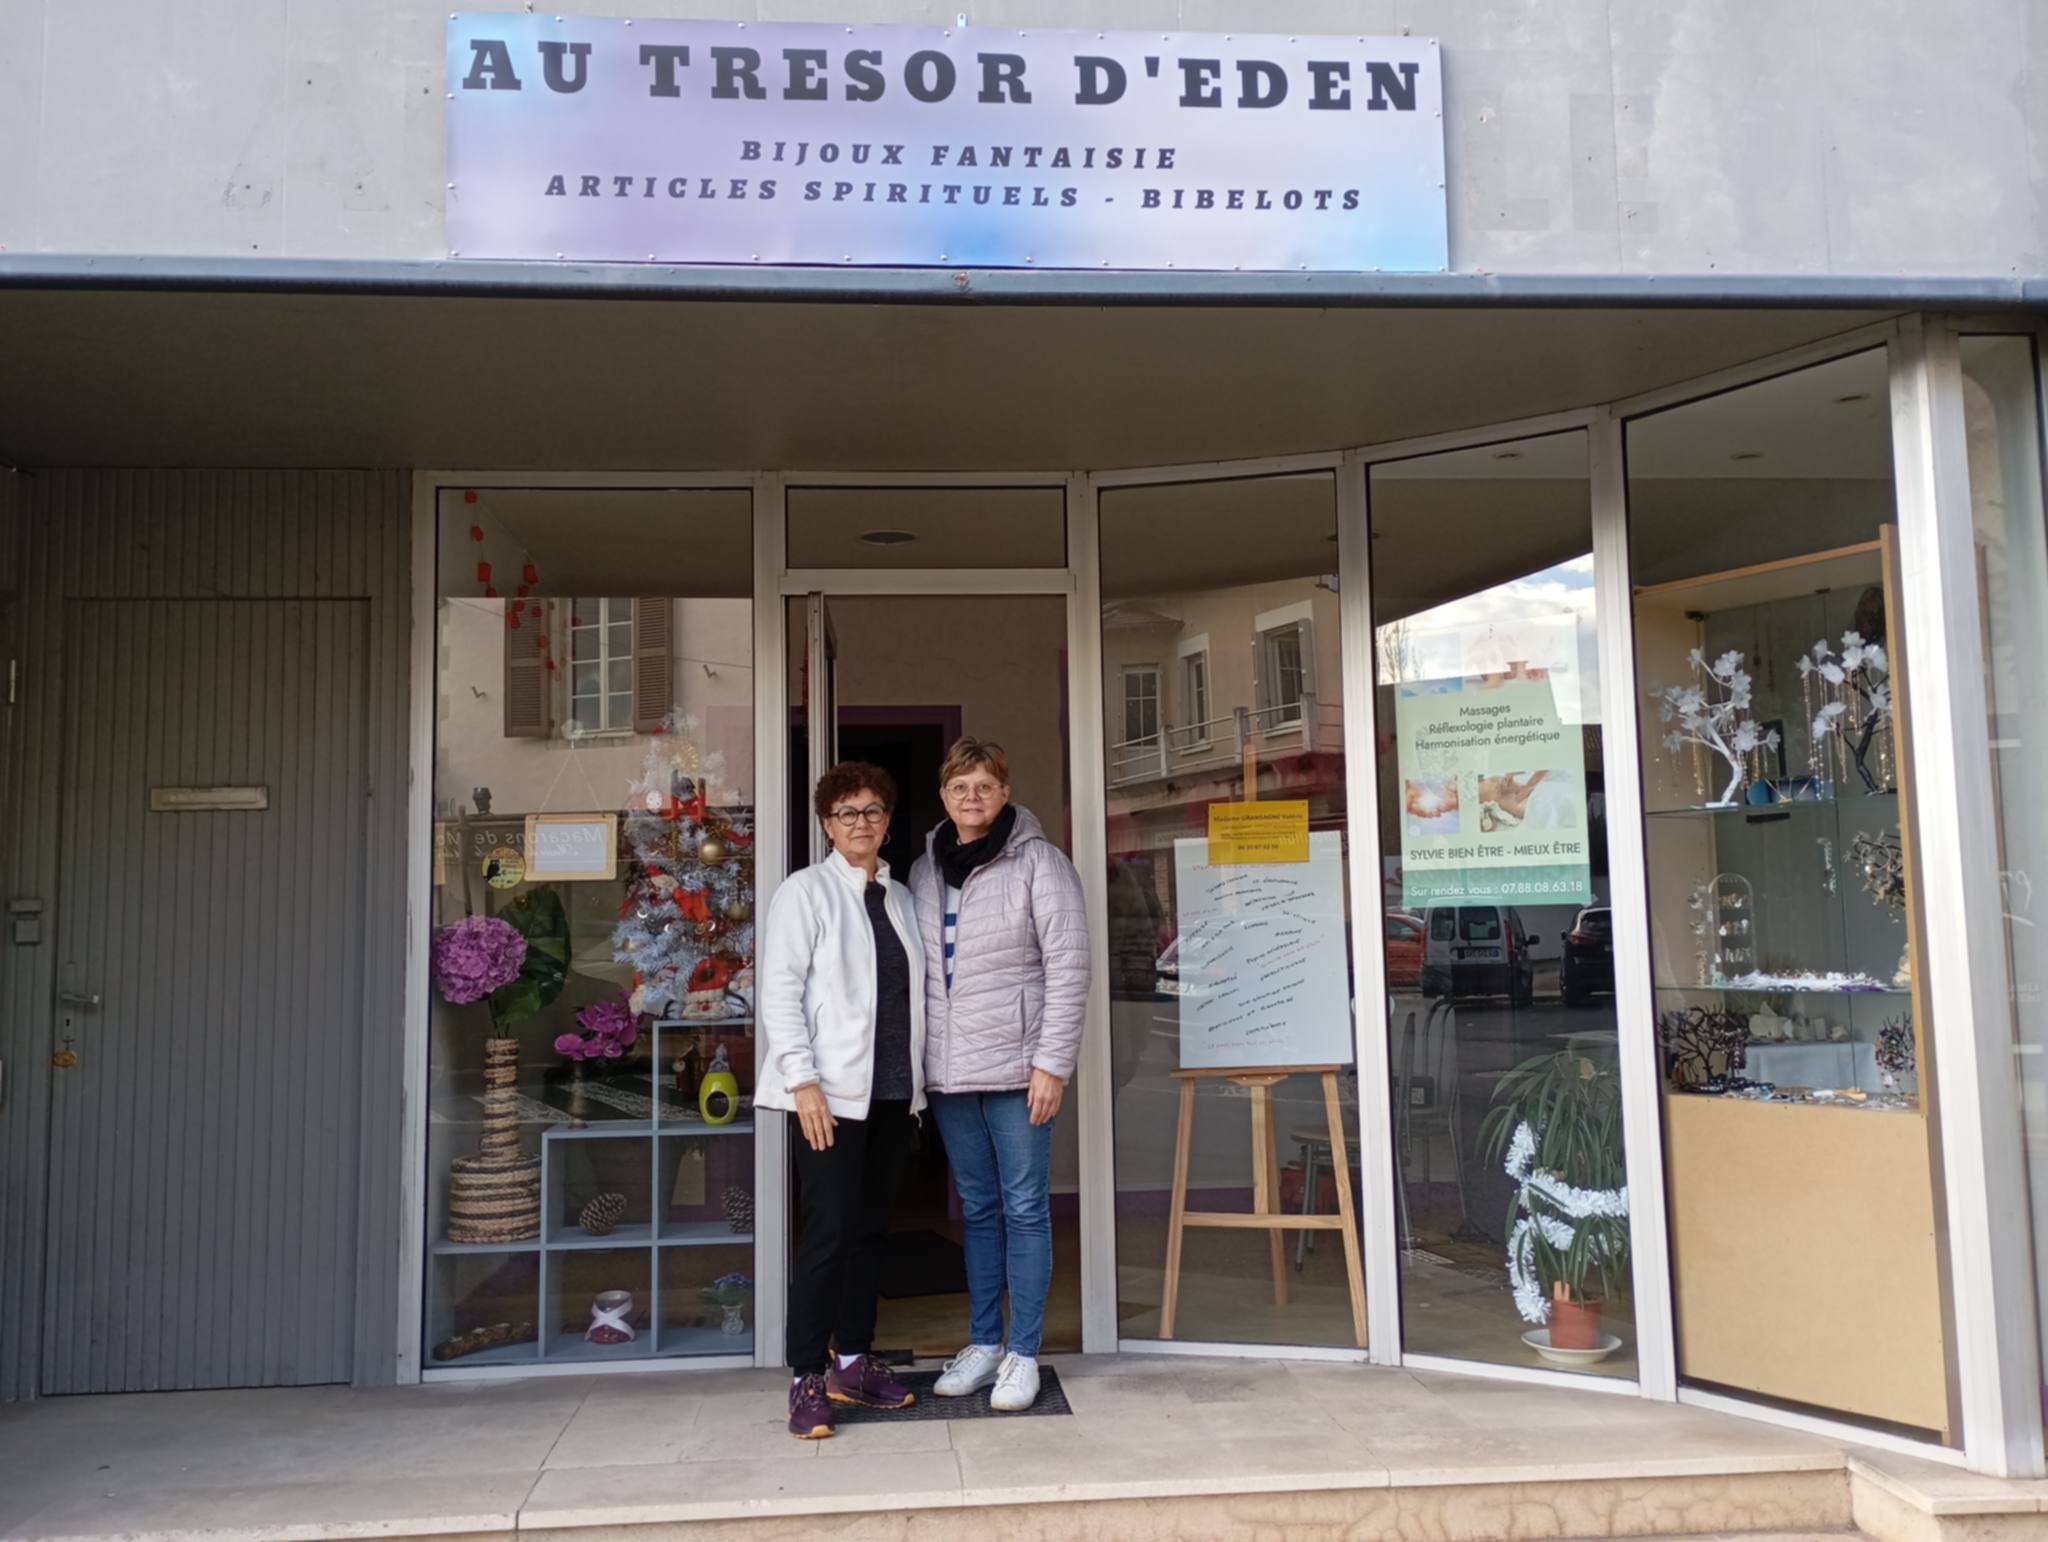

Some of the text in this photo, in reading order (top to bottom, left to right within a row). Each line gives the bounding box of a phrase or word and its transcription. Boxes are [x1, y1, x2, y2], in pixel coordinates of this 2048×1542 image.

[462, 39, 1419, 111] AU TRESOR D'EDEN
[740, 140, 1176, 169] BIJOUX FANTAISIE
[545, 175, 777, 200] ARTICLES
[804, 181, 1077, 207] SPIRITUELS
[1141, 189, 1360, 210] BIBELOTS
[1459, 704, 1511, 717] Massages
[1429, 715, 1544, 734] Réflexologie plantaire
[1415, 730, 1560, 750] Harmonisation énergétique
[1410, 849, 1445, 860] SYLVIE
[1449, 847, 1474, 859] BIEN
[1477, 844, 1504, 857] ÊTRE
[1513, 843, 1550, 855] MIEUX
[1553, 841, 1581, 854] ÊTRE
[1410, 886, 1427, 896] Sur
[1430, 884, 1464, 896] rendez
[1468, 885, 1491, 895] vous
[1501, 881, 1583, 894] 07.88.08.63.18
